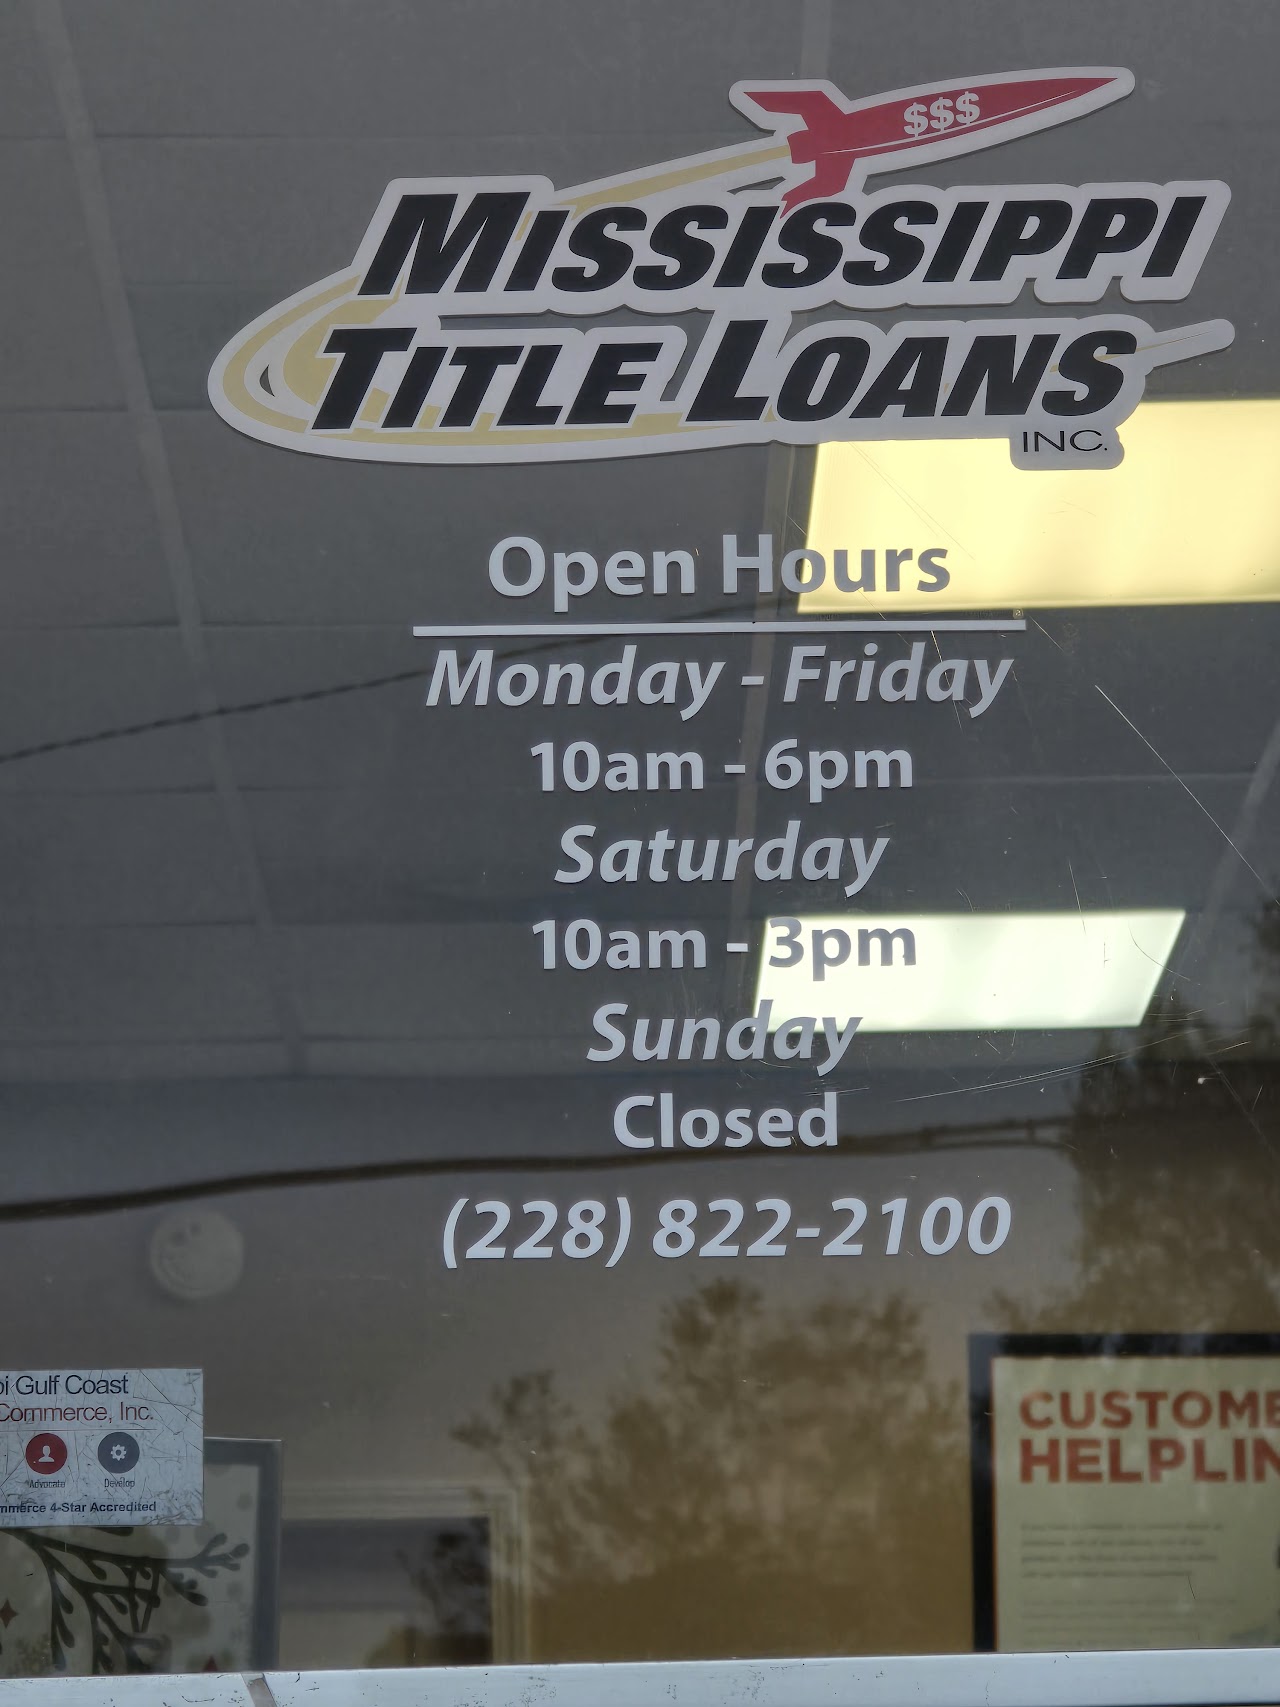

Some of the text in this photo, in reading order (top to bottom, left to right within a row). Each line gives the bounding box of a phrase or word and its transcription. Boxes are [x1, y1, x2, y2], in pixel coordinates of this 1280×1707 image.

[357, 191, 1207, 296] MISSISSIPPI
[311, 319, 1138, 430] TITLE LOANS
[1022, 429, 1108, 453] INC.
[488, 533, 951, 613] Open Hours
[426, 642, 1014, 721] Monday - Friday
[530, 739, 914, 803] 10am - 6pm
[554, 820, 890, 898] Saturday
[532, 917, 917, 982] 10am - 3pm
[586, 999, 863, 1077] Sunday
[613, 1092, 839, 1149] Closed
[443, 1196, 1012, 1269] (228) 822-2100
[0, 1402, 154, 1424] Commerce, Inc.
[16, 1375, 60, 1395] Gulf
[65, 1374, 129, 1395] Coast
[29, 1480, 66, 1489] Advocate
[104, 1478, 136, 1489] Develop
[1019, 1438, 1280, 1484] HELPLIN
[50, 1502, 87, 1513] 4-Star
[90, 1501, 156, 1513] Accredited
